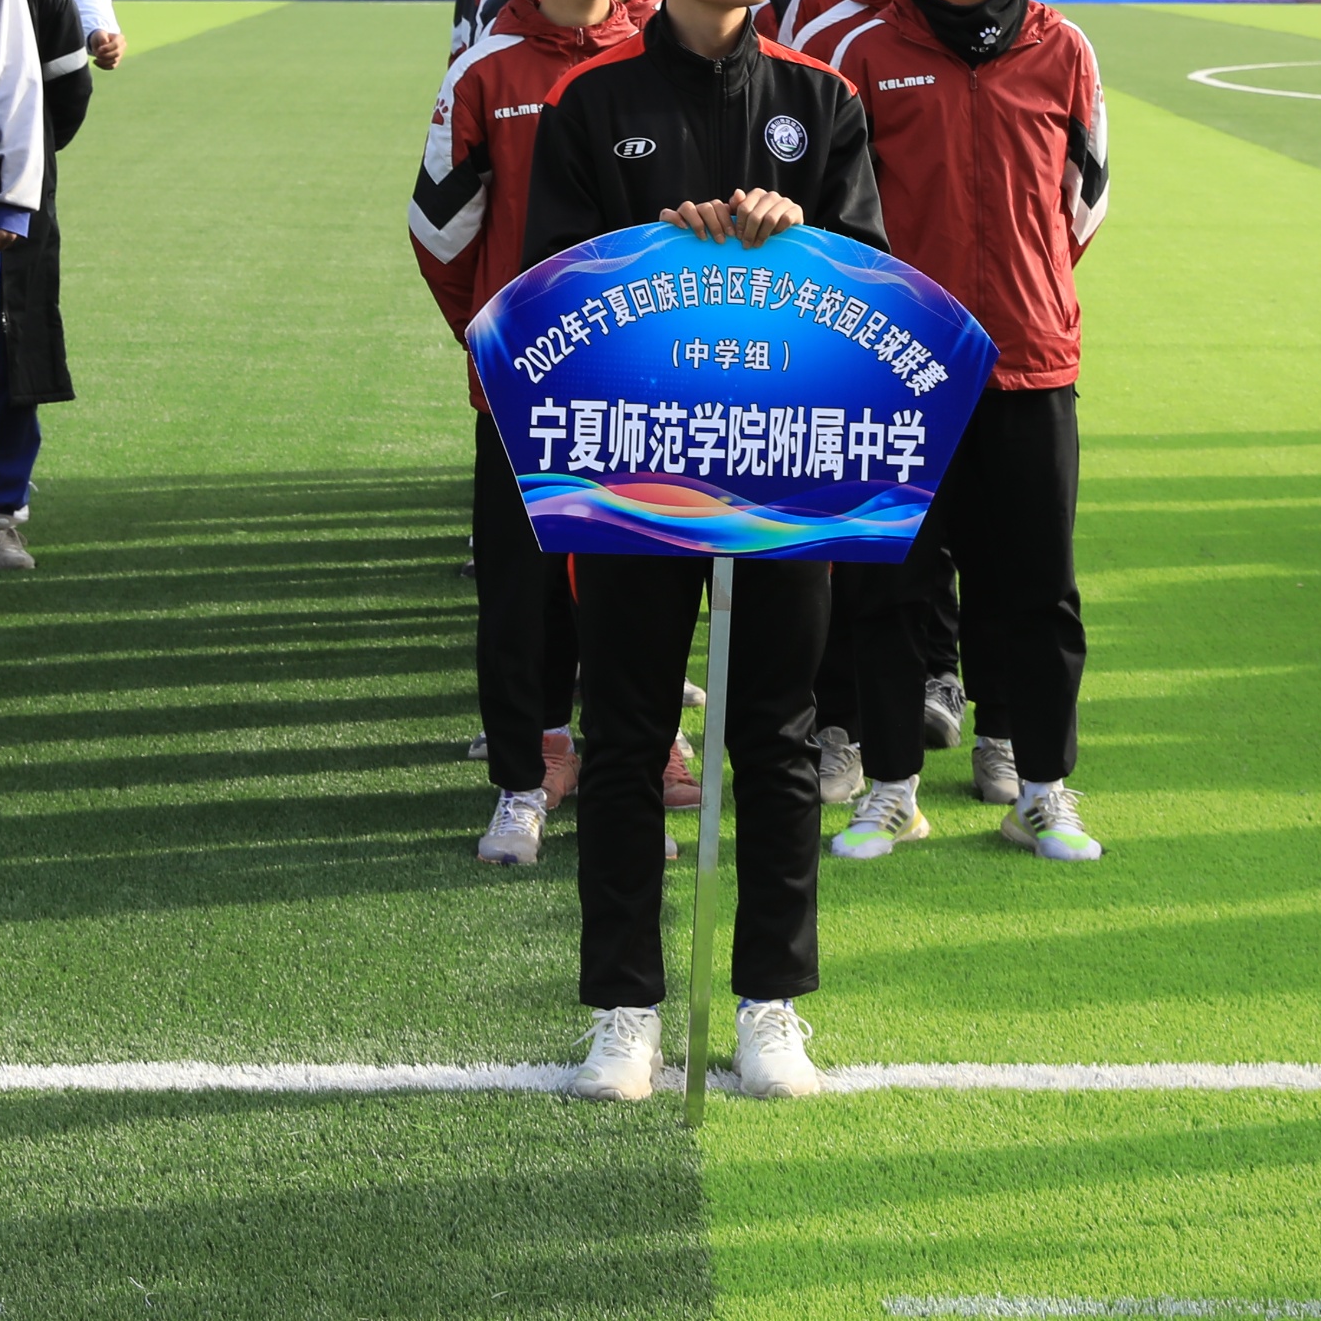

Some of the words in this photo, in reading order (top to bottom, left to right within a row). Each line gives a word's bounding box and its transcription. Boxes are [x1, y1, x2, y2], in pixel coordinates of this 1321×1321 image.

[878, 75, 925, 91] KELME
[494, 103, 538, 120] KELME
[513, 264, 950, 398] 2022年宁夏回族自治区青少年校园足球联赛
[528, 396, 927, 485] 宁夏师范学院附属中学
